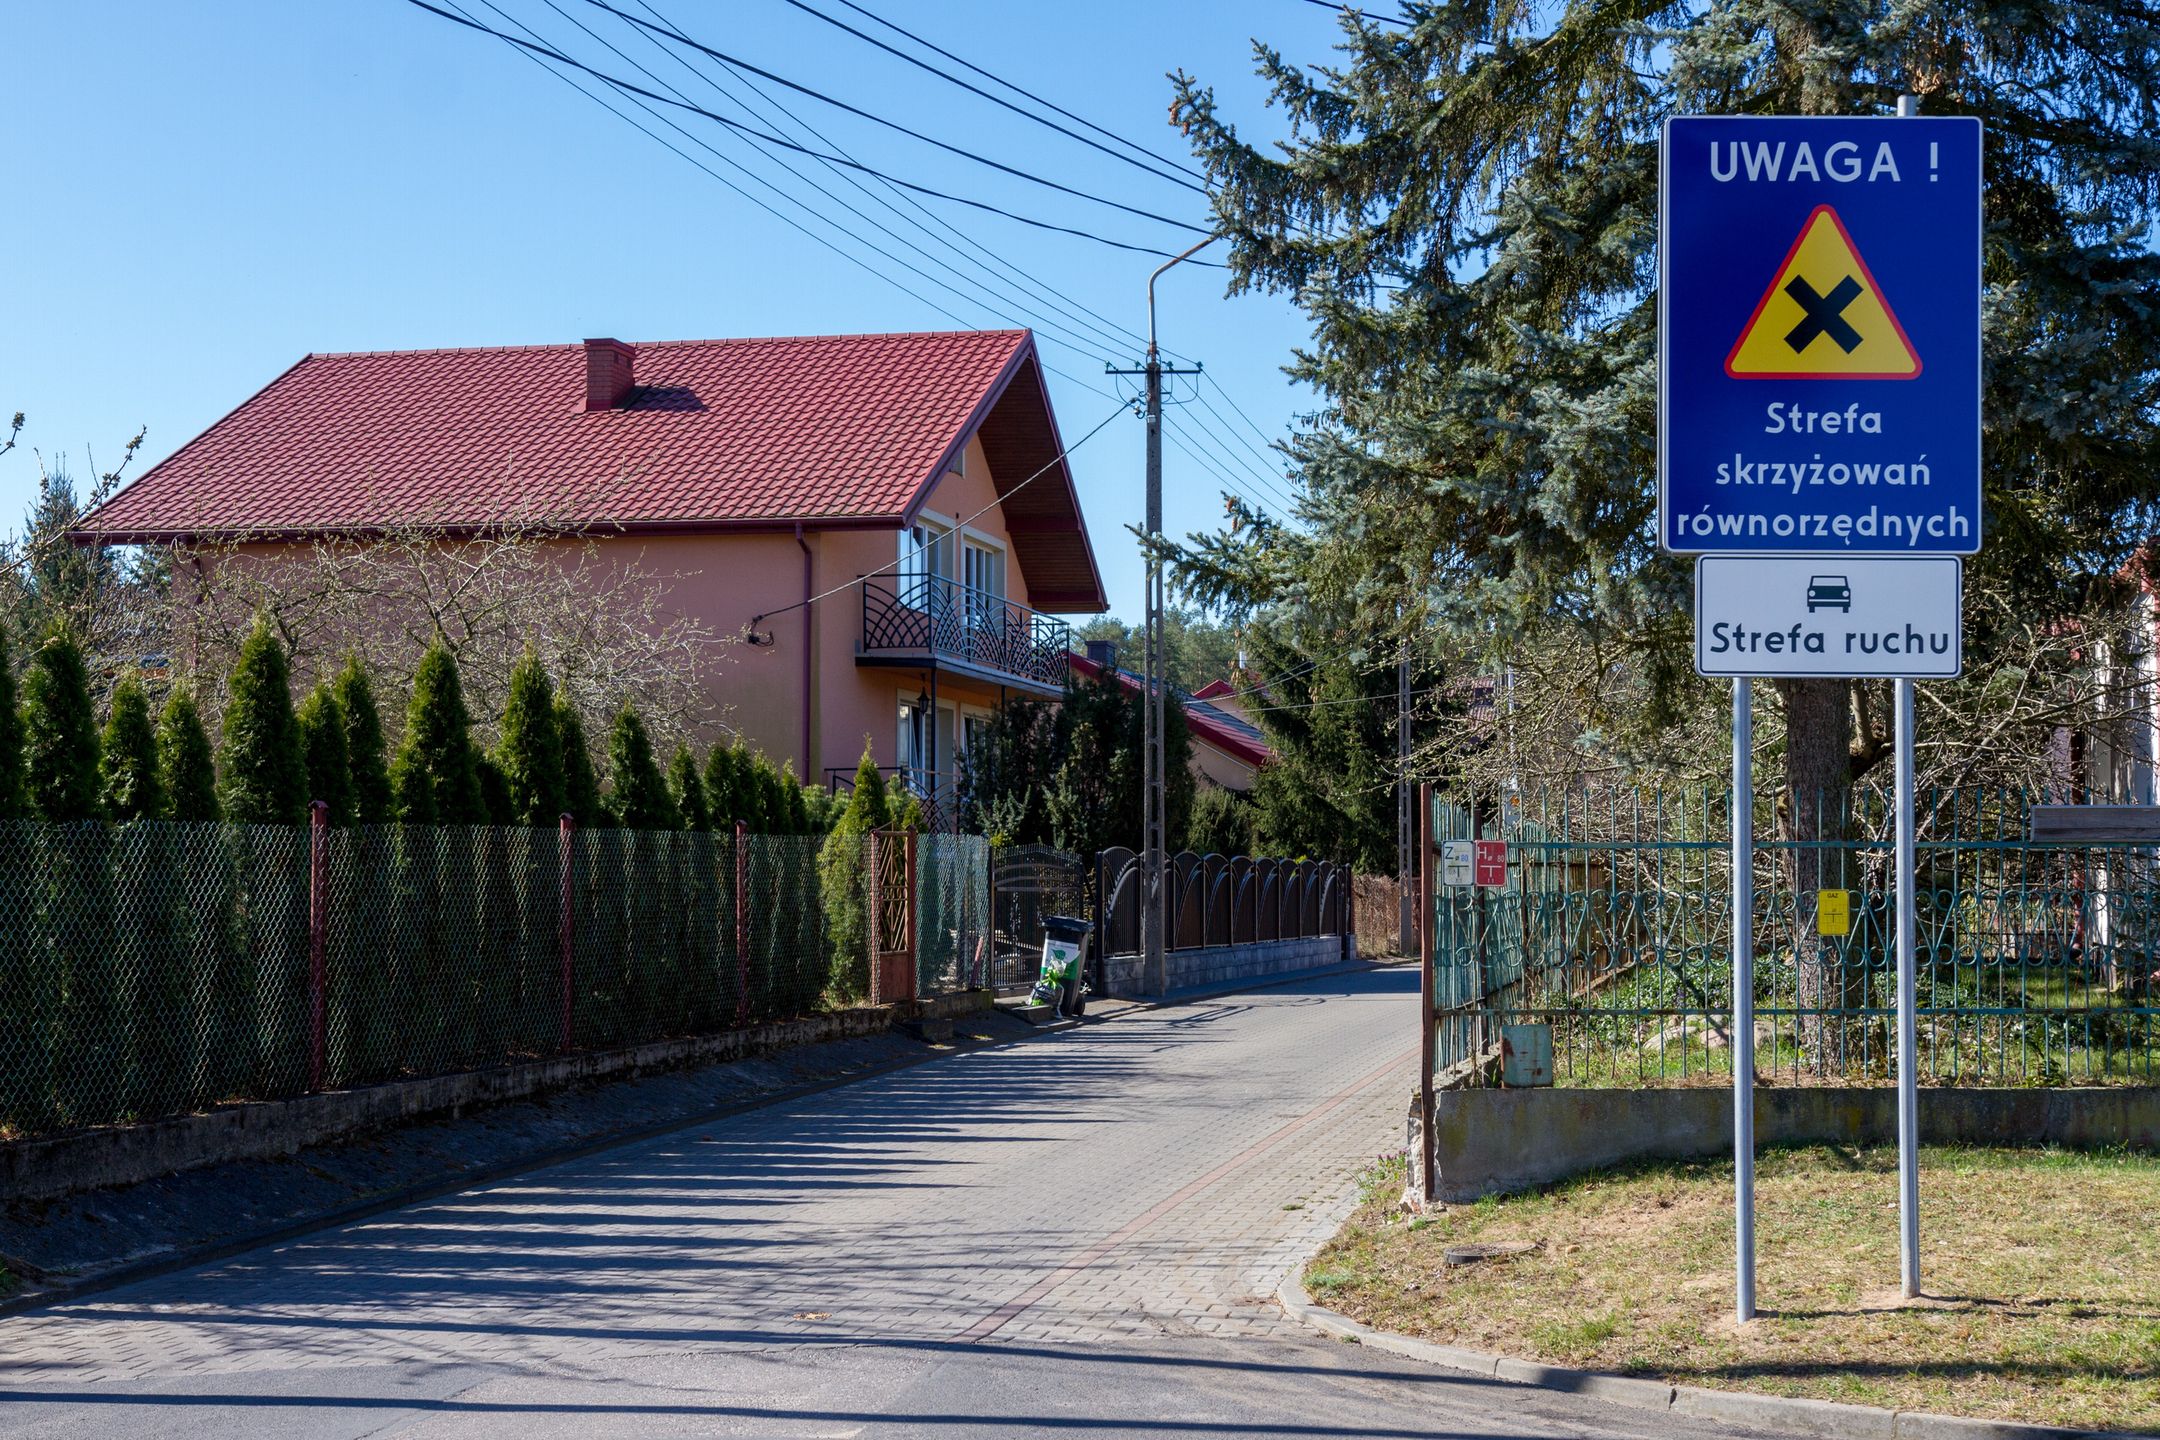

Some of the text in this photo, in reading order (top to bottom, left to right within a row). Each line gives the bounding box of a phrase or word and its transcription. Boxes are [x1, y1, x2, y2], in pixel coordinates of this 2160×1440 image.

[1711, 141, 1938, 182] UWAGA !
[1765, 402, 1882, 434] Strefa
[1716, 453, 1930, 494] skrzyżowań
[1678, 505, 1969, 545] równorzędnych
[1710, 622, 1950, 654] Strefa ruchu
[1445, 847, 1454, 859] Z
[1478, 847, 1487, 859] H
